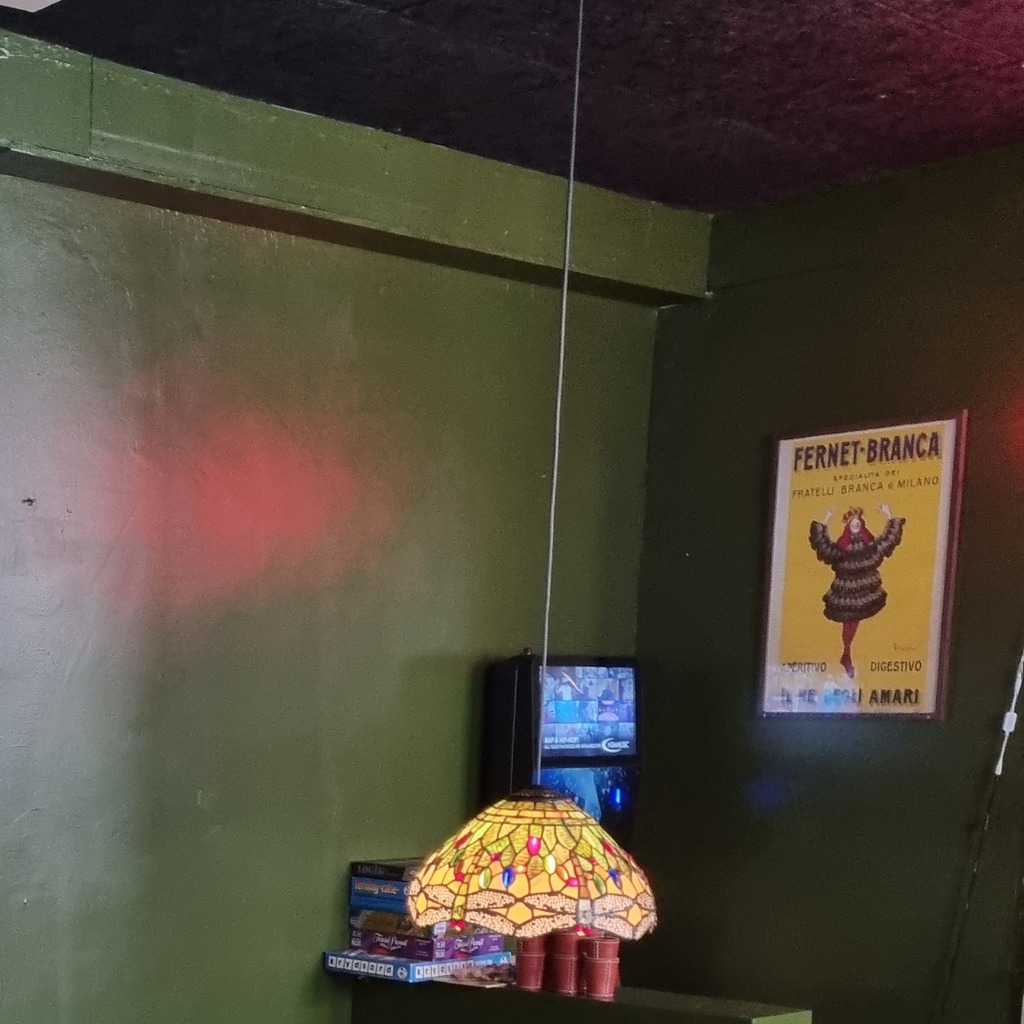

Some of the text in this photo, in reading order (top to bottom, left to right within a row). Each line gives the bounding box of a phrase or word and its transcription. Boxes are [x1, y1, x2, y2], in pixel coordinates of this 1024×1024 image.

[792, 487, 835, 499] FRATELLI
[841, 481, 884, 495] BRANCA
[897, 476, 940, 488] MILANO
[870, 659, 922, 672] DIGESTIVO
[869, 687, 919, 705] AMARI
[330, 957, 392, 974] krydsord
